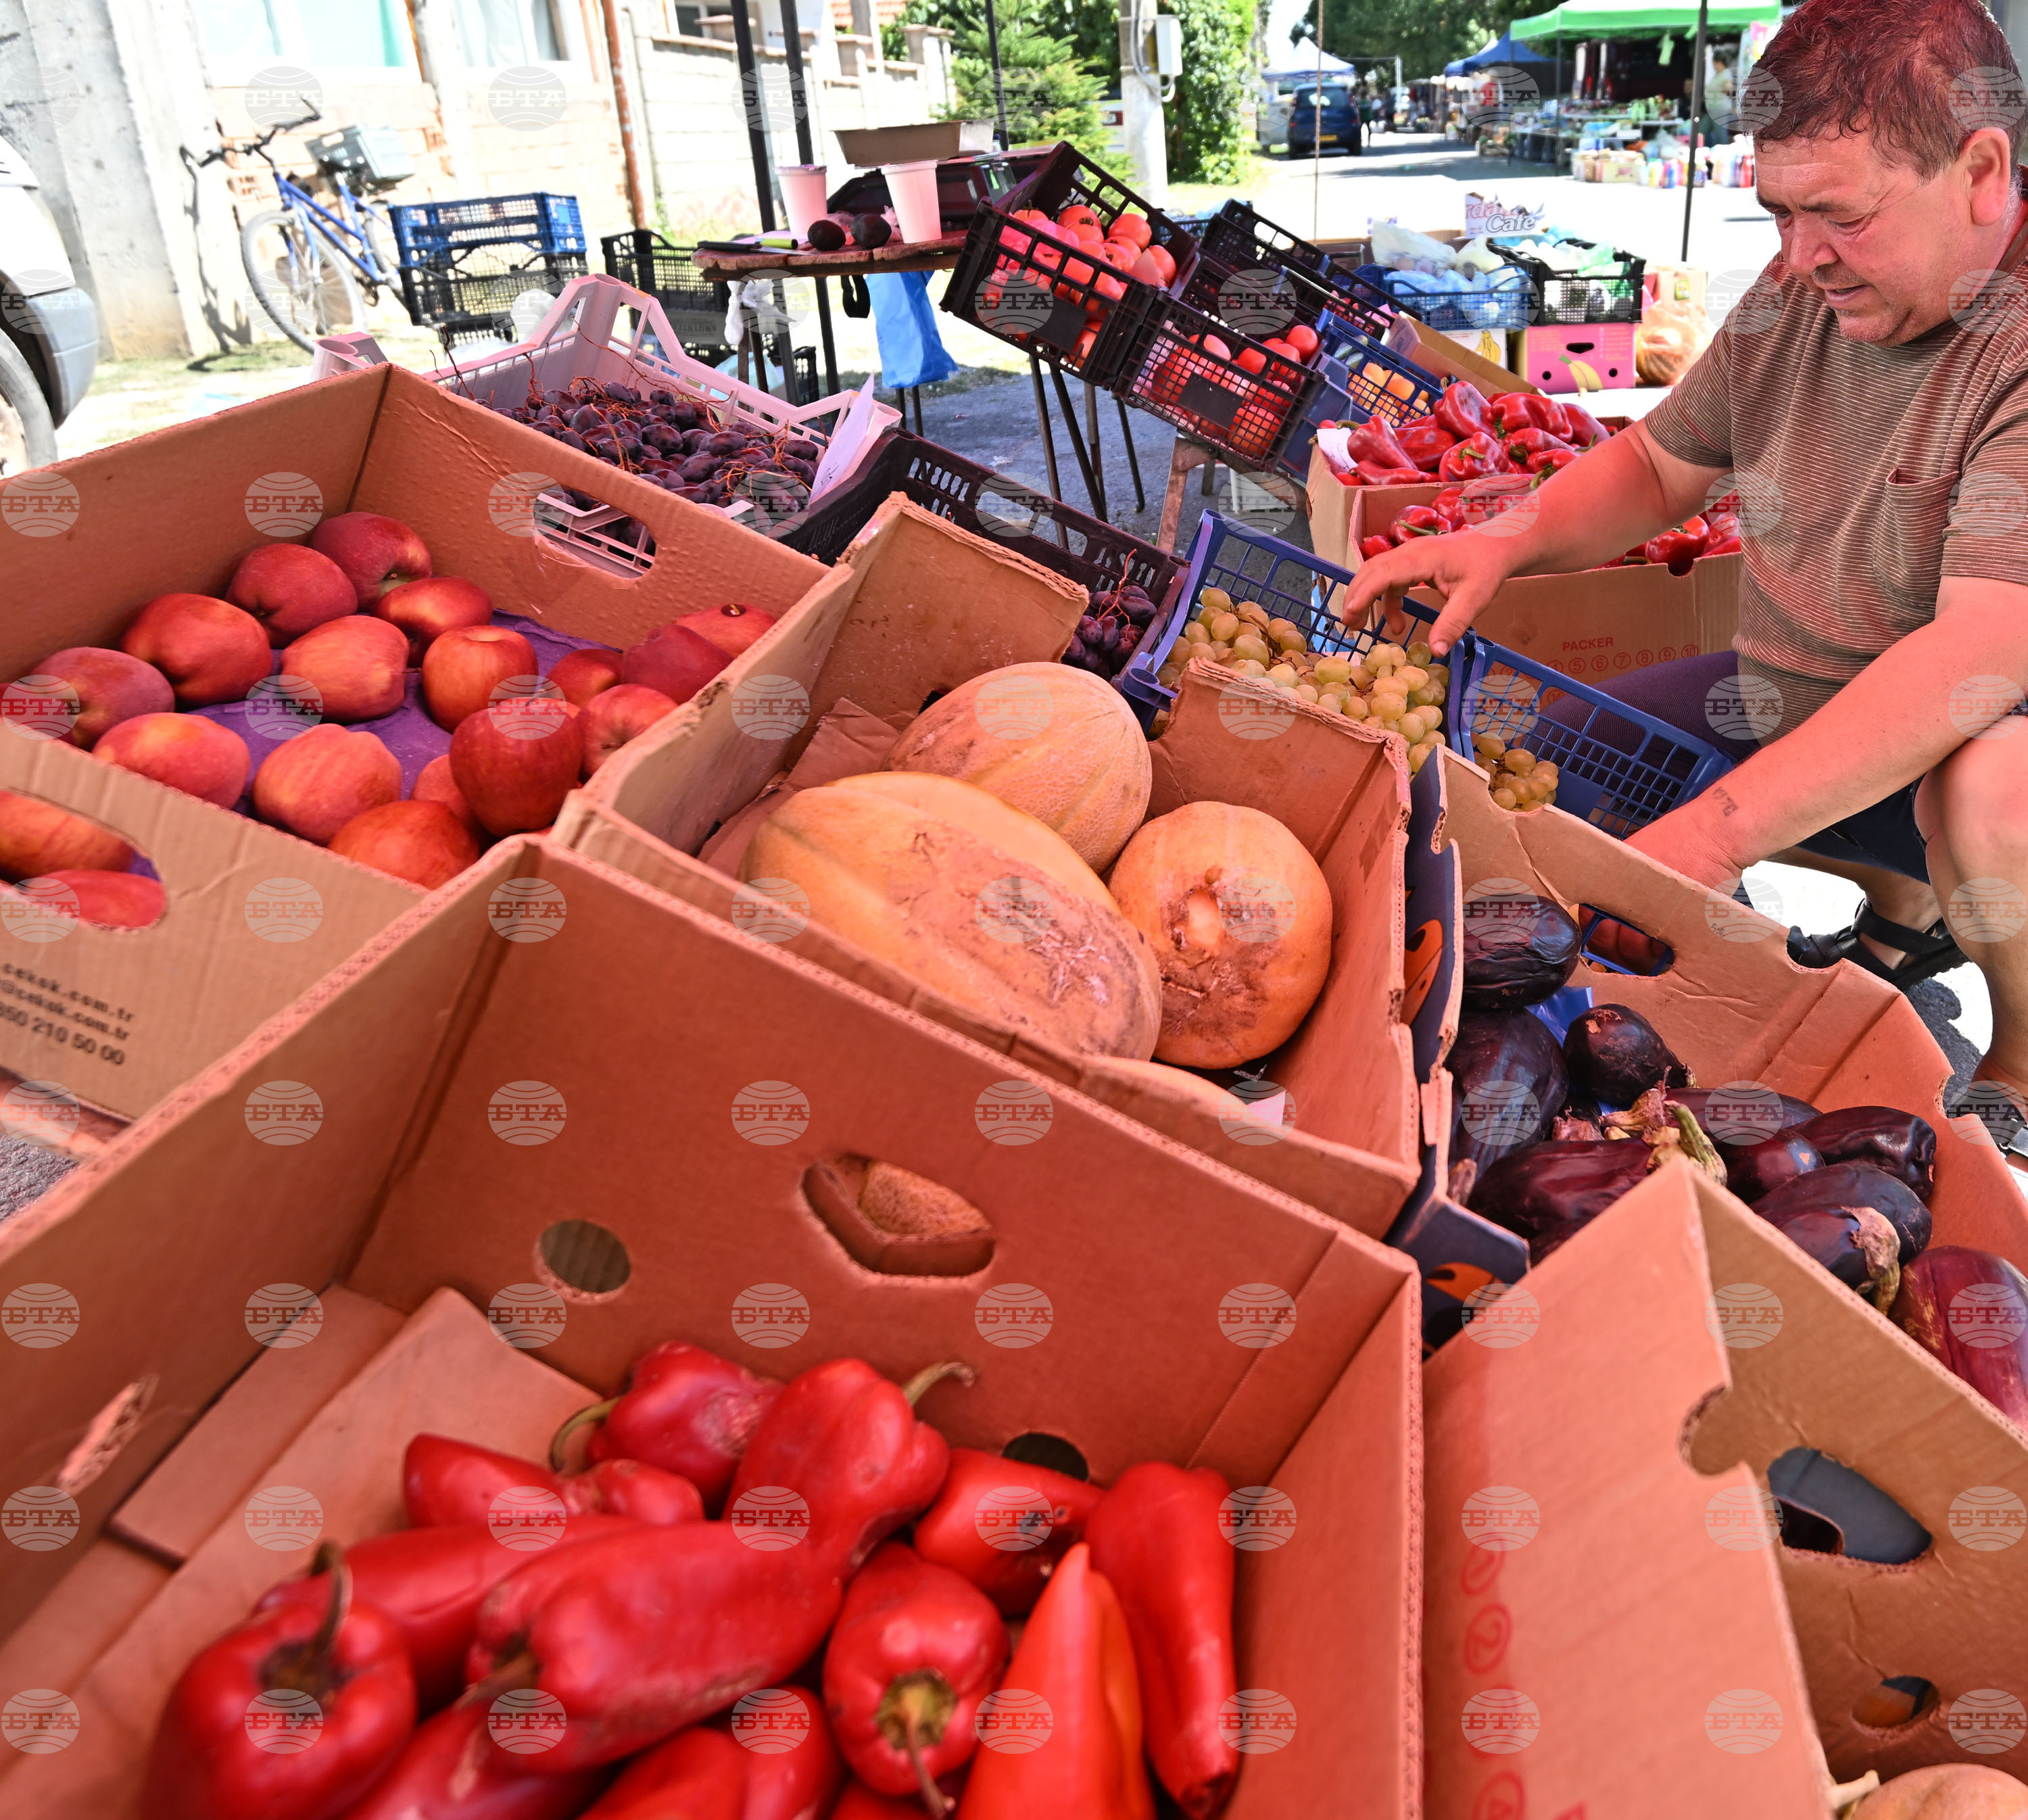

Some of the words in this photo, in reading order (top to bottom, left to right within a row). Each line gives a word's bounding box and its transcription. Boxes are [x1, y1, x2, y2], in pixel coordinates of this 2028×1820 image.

[1562, 637, 1614, 652] PACKER
[32, 1016, 68, 1043] 210
[72, 1032, 97, 1053] 50
[100, 1045, 126, 1065] 00
